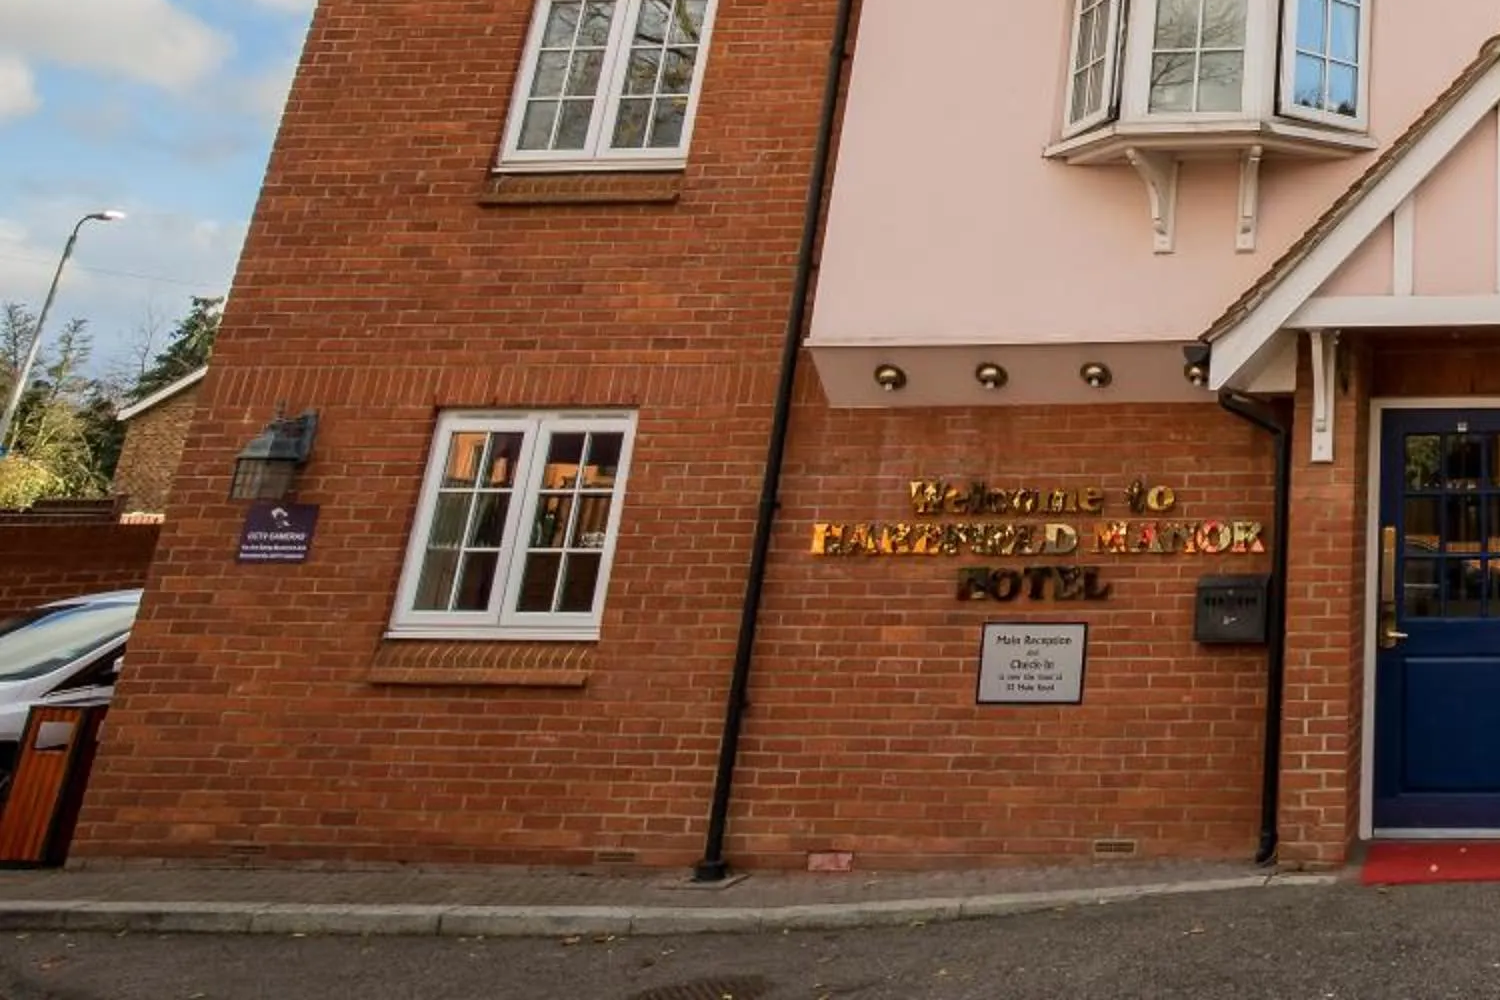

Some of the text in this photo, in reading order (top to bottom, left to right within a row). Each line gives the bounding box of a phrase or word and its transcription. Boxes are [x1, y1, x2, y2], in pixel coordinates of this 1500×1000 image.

[909, 476, 1176, 514] Welcome to
[811, 519, 1266, 556] HAREFIELD MANOR
[955, 566, 1113, 601] HOTEL
